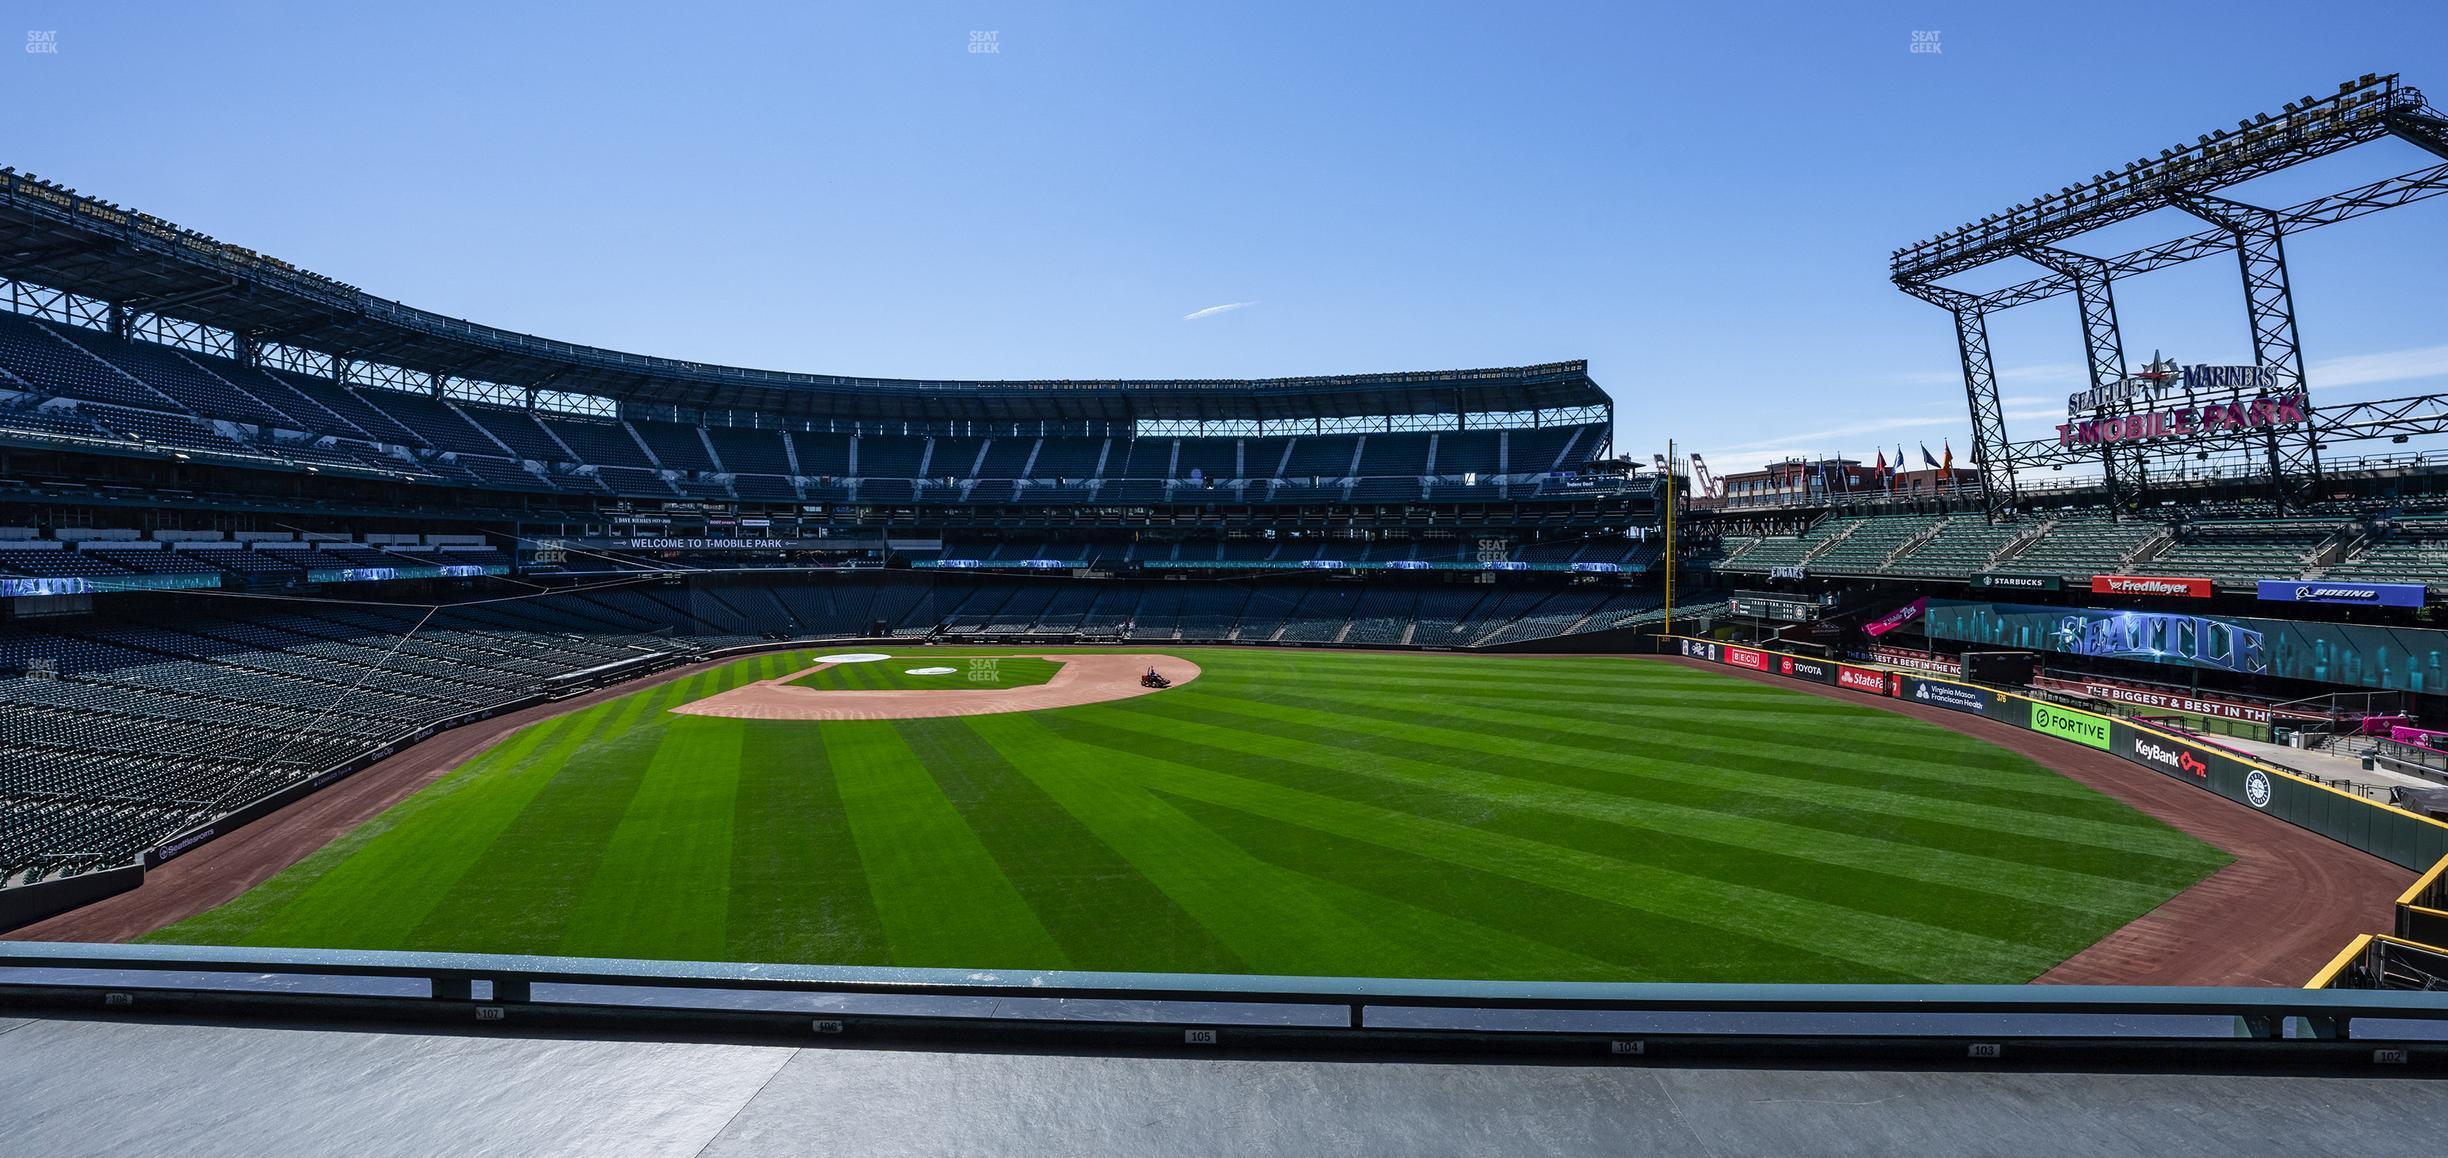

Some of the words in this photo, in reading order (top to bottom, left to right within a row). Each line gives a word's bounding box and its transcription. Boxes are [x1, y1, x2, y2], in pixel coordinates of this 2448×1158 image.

[2068, 378, 2140, 416] SEATTLE
[2182, 363, 2279, 389] MARINERS
[2056, 406, 2198, 447] T-MOBILE
[2204, 392, 2310, 432] PARK
[630, 538, 684, 548] WELCOME
[688, 538, 702, 548] TO
[705, 539, 754, 548] T-MOBILE
[755, 539, 782, 548] PARK
[1994, 577, 2043, 586] STARBUCKS
[2314, 588, 2376, 598] BOEING
[1734, 653, 1757, 664] BECU
[1892, 657, 1898, 665] &
[1900, 659, 1920, 668] BEST
[1921, 661, 1930, 670] IN
[1932, 663, 1948, 672] THE
[1794, 663, 1823, 675] TOYOTA
[1931, 686, 1954, 696] Virginia
[1955, 690, 1976, 699] Mason
[1931, 693, 1964, 705] Franciscan
[1964, 699, 1984, 710] Health
[2086, 686, 2109, 697] THE
[2112, 690, 2167, 705] BIGGEST
[2171, 698, 2179, 708] &
[2184, 700, 2220, 714] BEST
[2225, 706, 2240, 717] IN
[2052, 715, 2105, 740] FORTIVE
[2135, 738, 2180, 768] KeyBank
[1191, 1031, 1211, 1042] 105
[1620, 1043, 1638, 1052] 104
[1976, 1045, 1994, 1056] 103
[2383, 1051, 2400, 1062] 102
